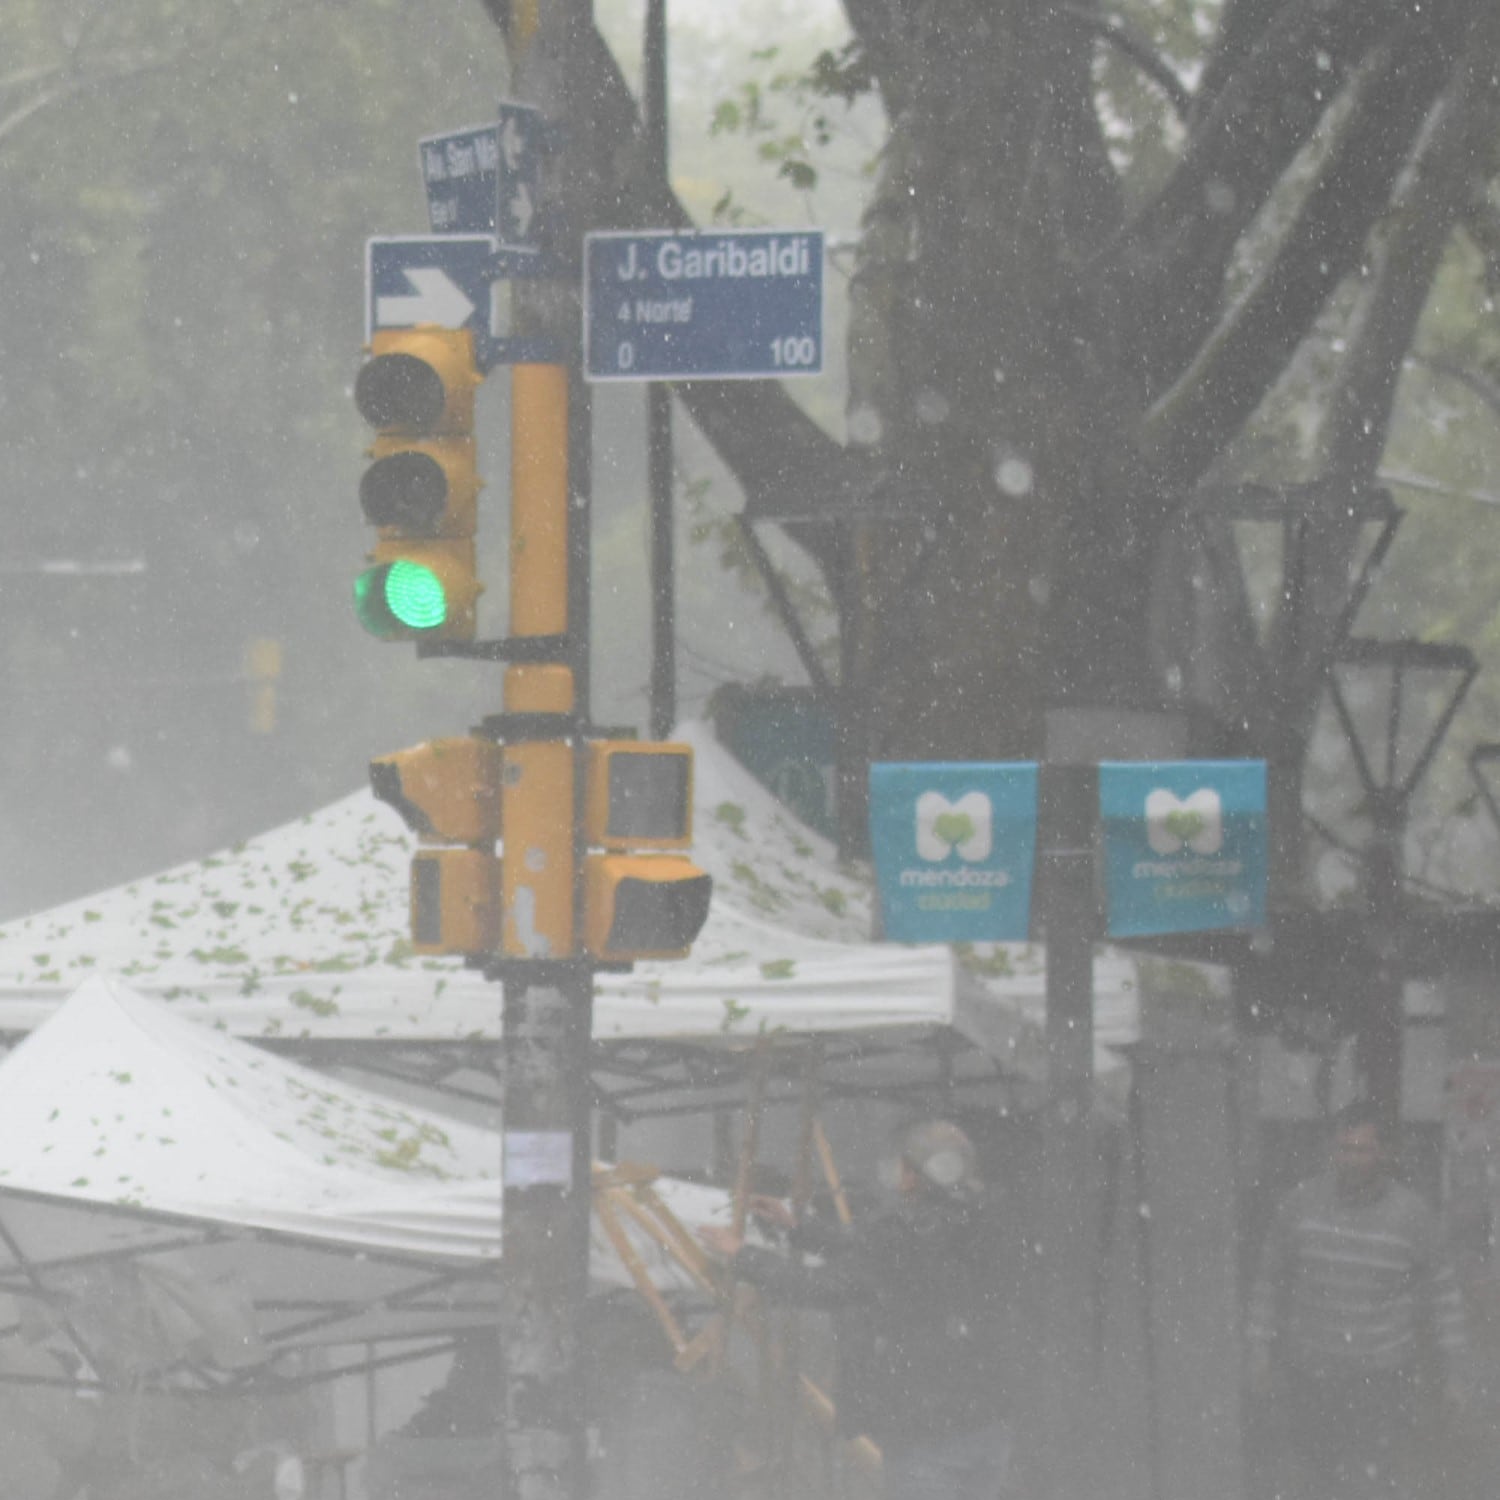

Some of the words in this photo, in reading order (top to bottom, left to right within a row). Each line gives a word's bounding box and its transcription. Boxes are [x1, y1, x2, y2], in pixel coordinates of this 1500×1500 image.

[616, 242, 648, 281] J.
[656, 238, 810, 279] Garibaldi
[635, 299, 692, 323] Norte
[769, 336, 816, 366] 100
[899, 865, 1008, 888] mendoza
